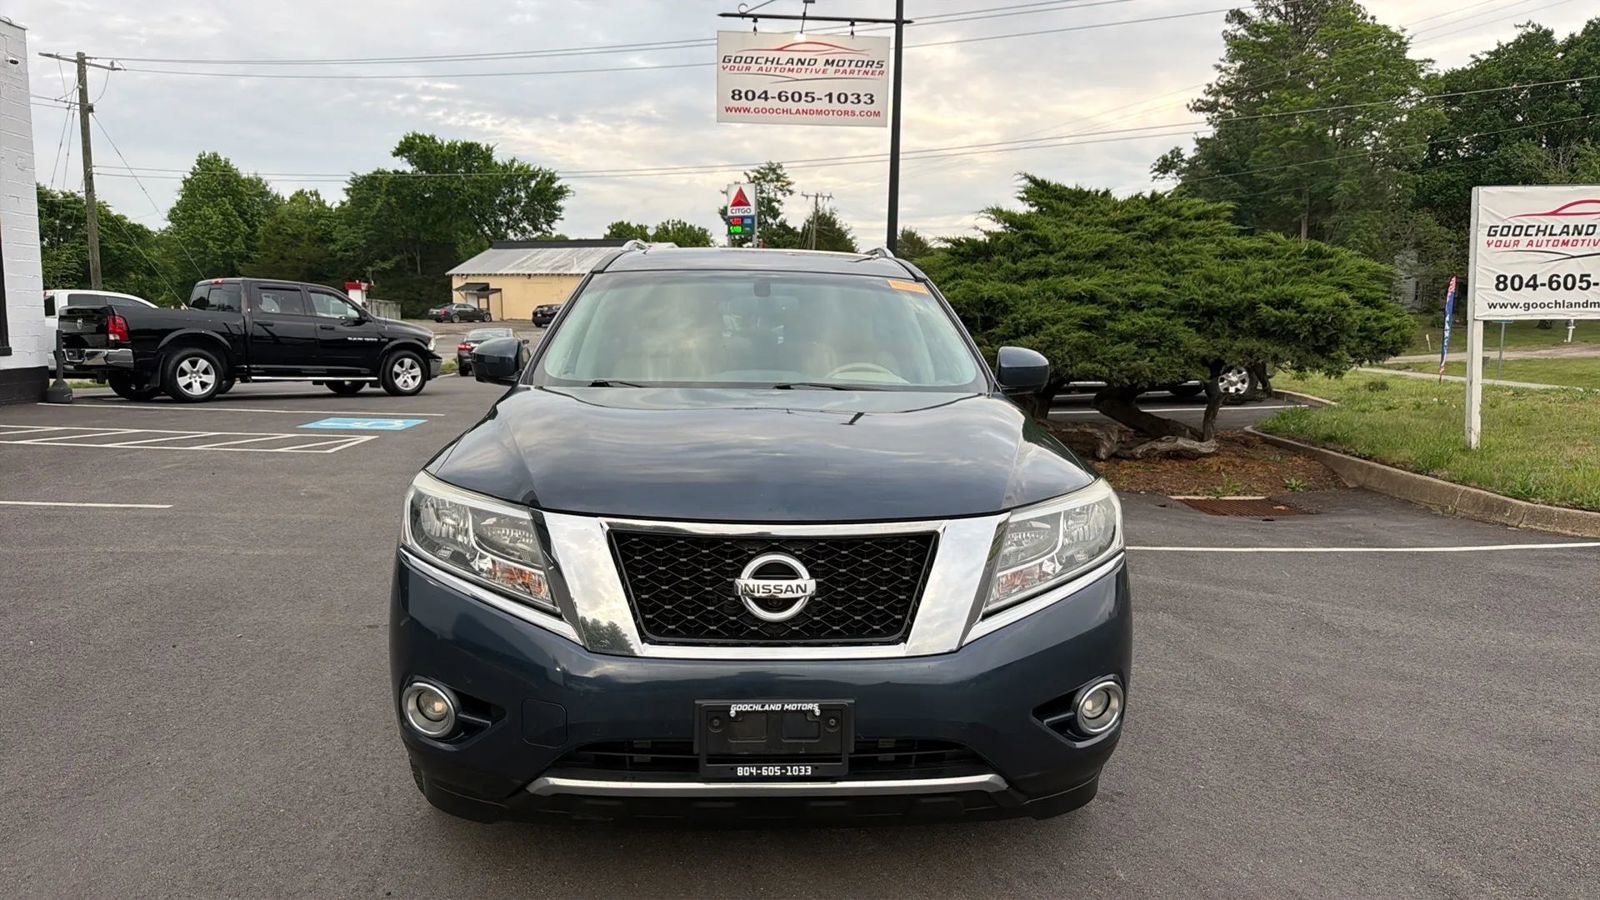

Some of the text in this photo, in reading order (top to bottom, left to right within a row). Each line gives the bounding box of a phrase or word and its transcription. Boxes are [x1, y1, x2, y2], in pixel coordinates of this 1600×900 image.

[722, 55, 885, 69] GOOCHLAND MOTORS
[757, 66, 828, 75] AUTOMOTIVE
[834, 68, 885, 77] PARTNER
[731, 89, 875, 105] 804-605-1033
[725, 106, 881, 118] WWW.GOOCHLANDMOTORS.COM
[1487, 224, 1597, 237] GOOCHLAND
[1487, 240, 1520, 248] YOUR
[1495, 274, 1600, 291] 804-605-
[744, 583, 808, 595] NISSAN
[784, 703, 819, 711] MOTORS
[737, 766, 812, 776] 804-605-1033
